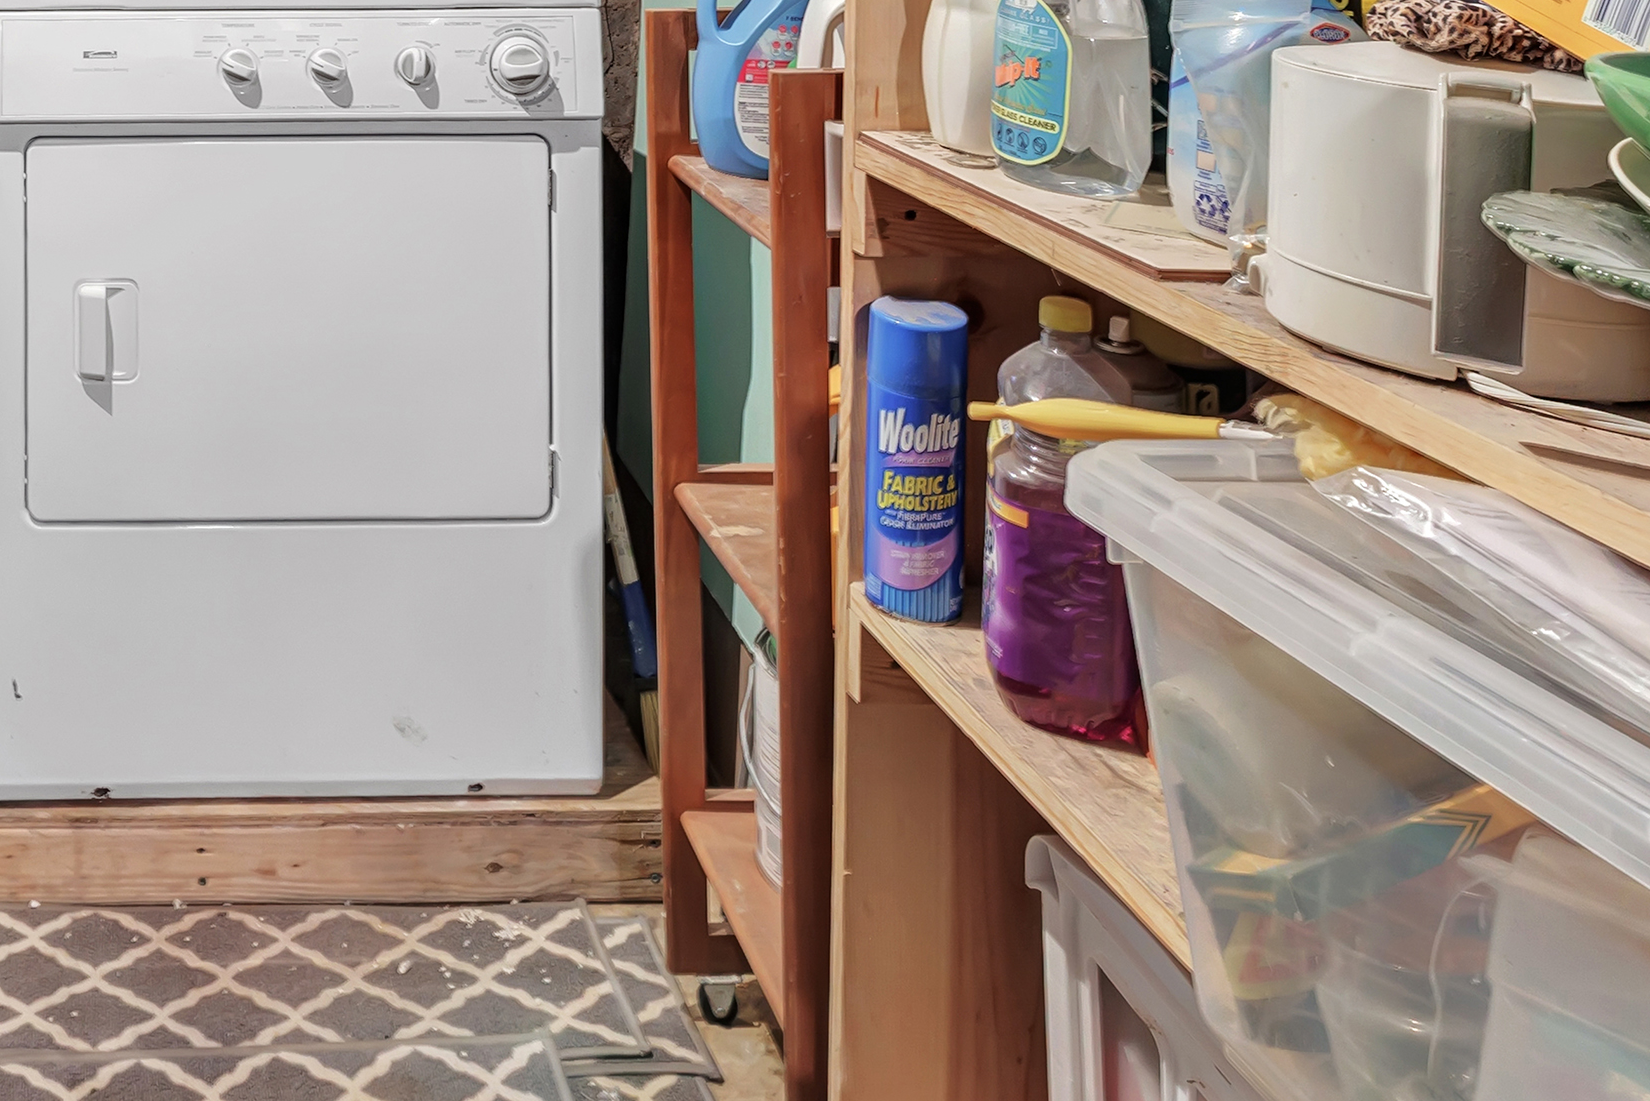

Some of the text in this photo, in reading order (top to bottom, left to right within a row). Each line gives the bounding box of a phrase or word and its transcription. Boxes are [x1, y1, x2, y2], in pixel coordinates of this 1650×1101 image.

[878, 407, 960, 454] Woolite
[883, 469, 955, 496] FABRIC &
[877, 489, 958, 512] UPHOLSTERY
